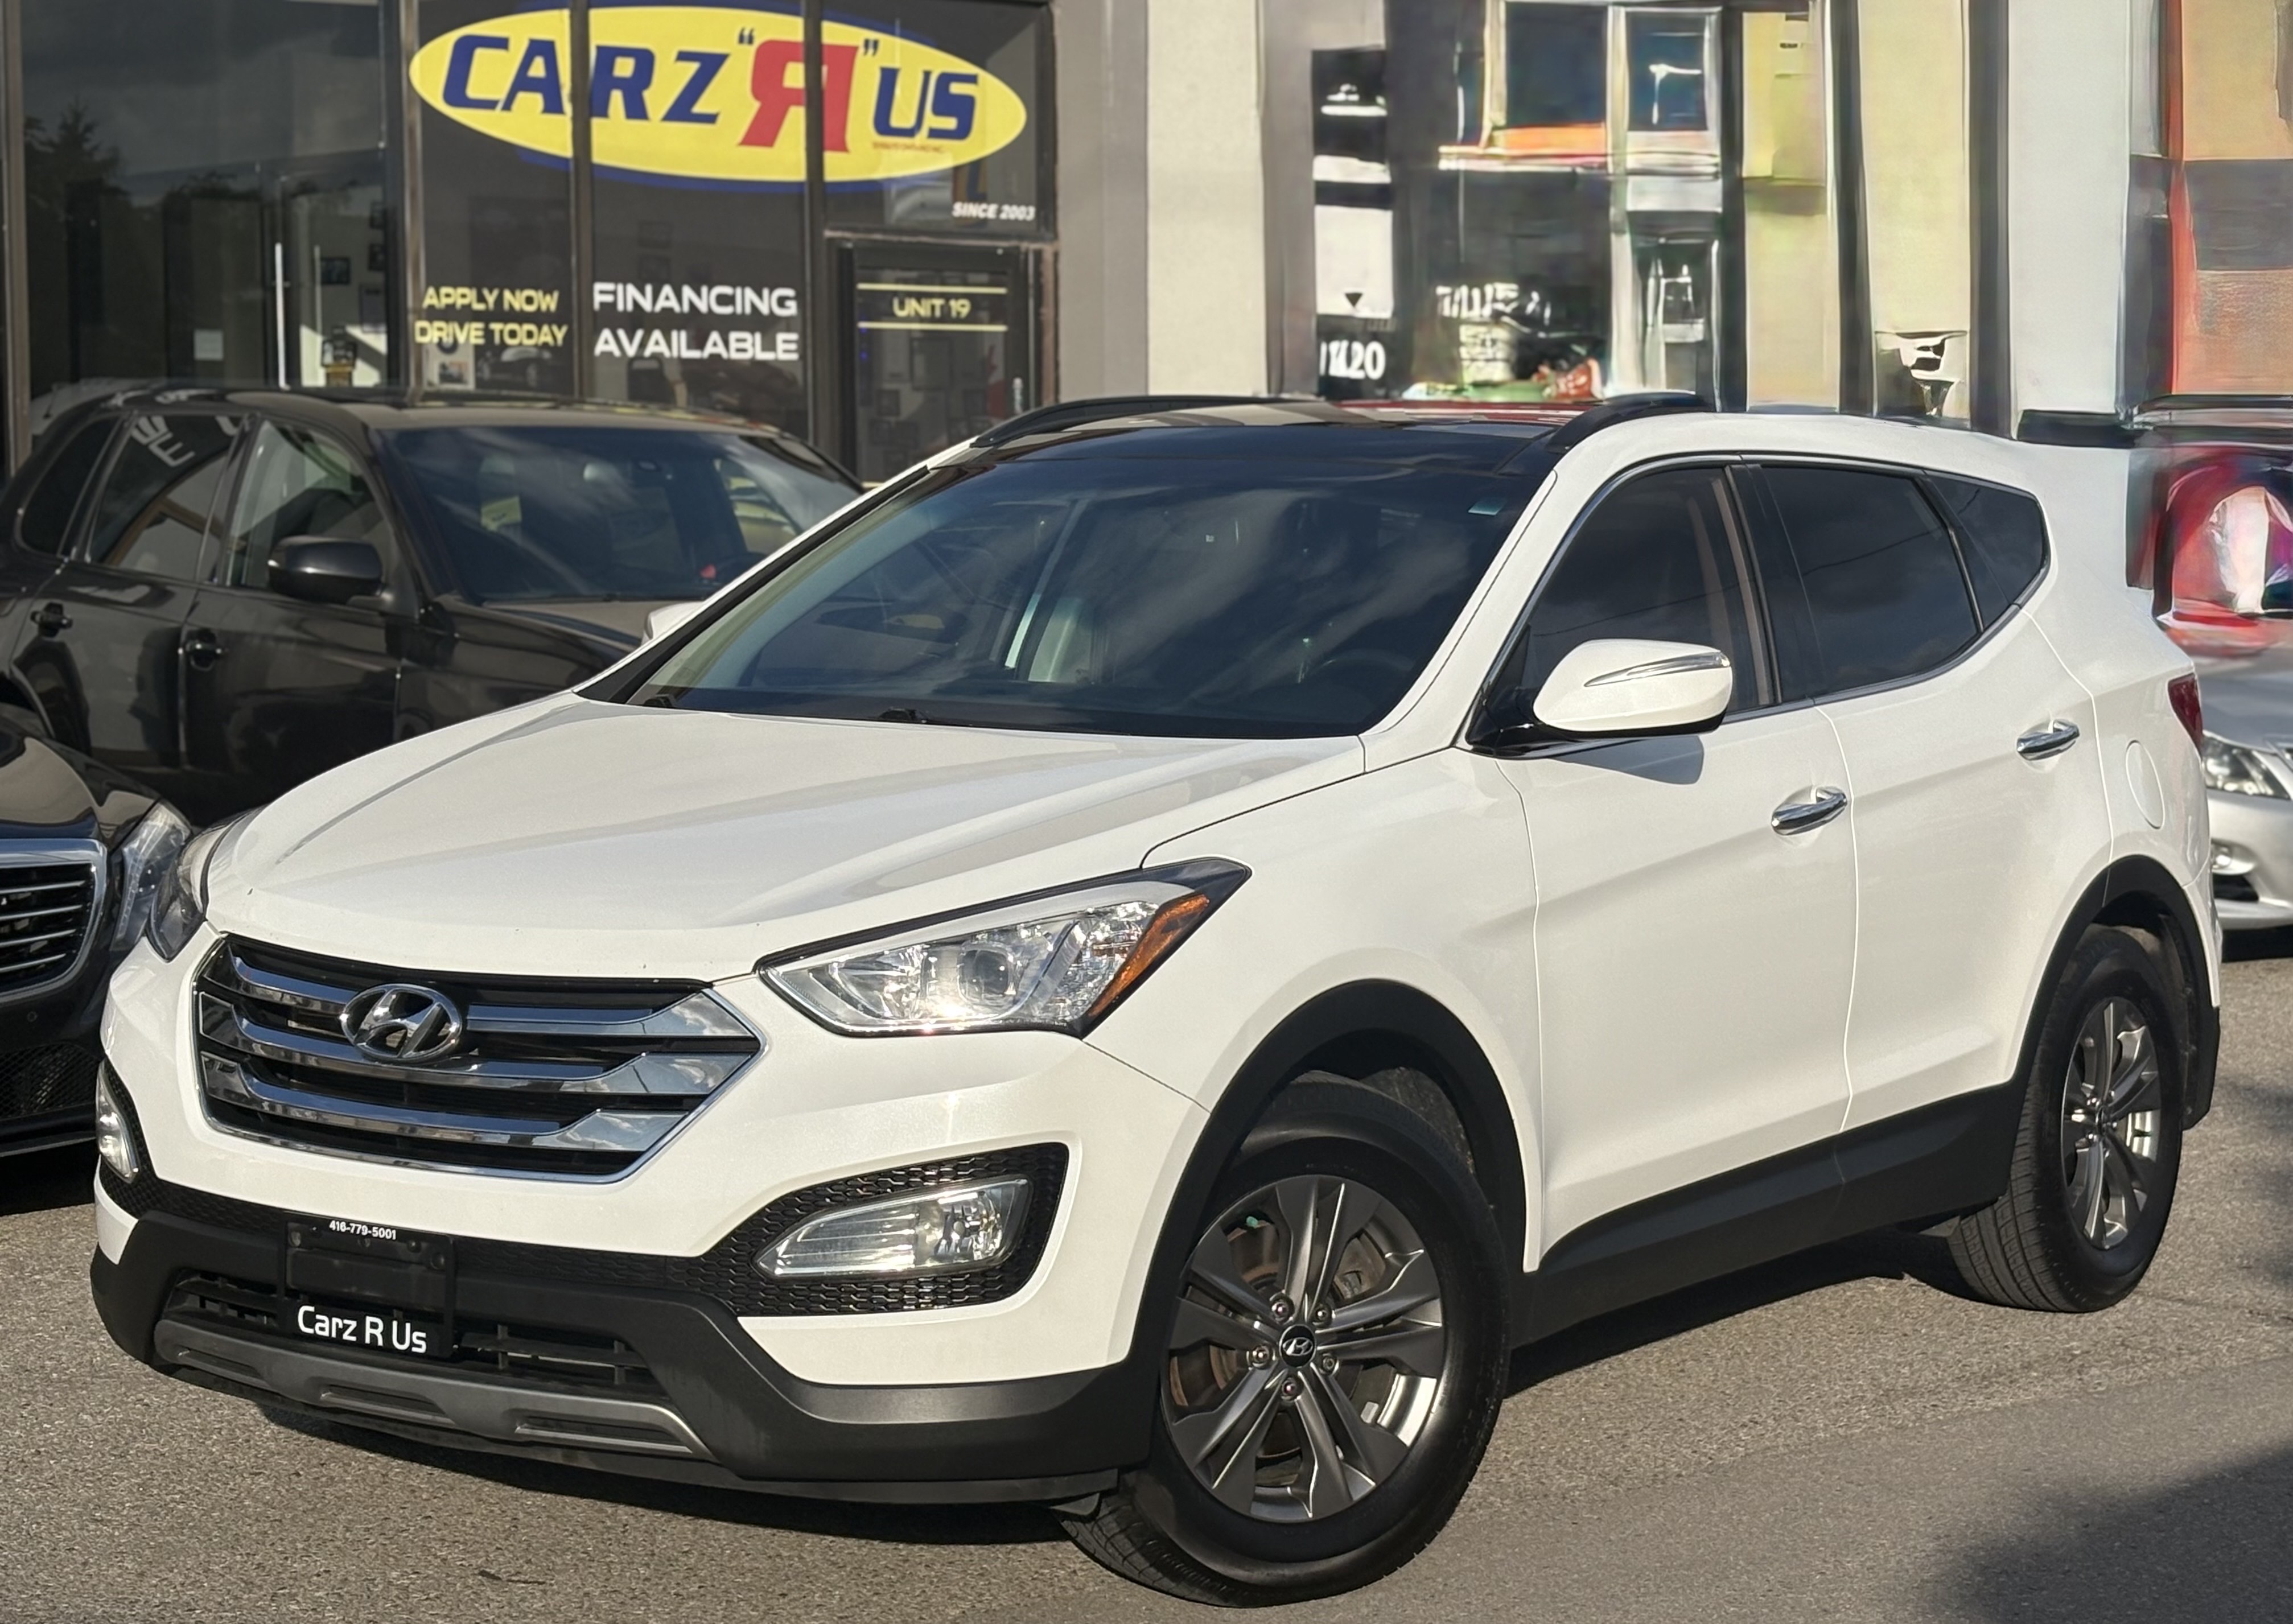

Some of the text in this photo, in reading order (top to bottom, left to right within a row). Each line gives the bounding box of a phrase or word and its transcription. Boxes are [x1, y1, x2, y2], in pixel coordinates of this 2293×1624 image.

[442, 34, 731, 125] CARZ
[872, 66, 978, 141] US
[952, 201, 1036, 221] SINCE 2003
[422, 286, 559, 312] APPLY NOW
[593, 281, 798, 317] FINANCING
[892, 296, 971, 319] UNIT 19
[414, 320, 569, 347] DRIVE TODAY
[594, 328, 800, 361] AVAILABLE
[329, 1220, 397, 1240] 416-779-5001
[298, 1305, 427, 1354] Carz R Us
